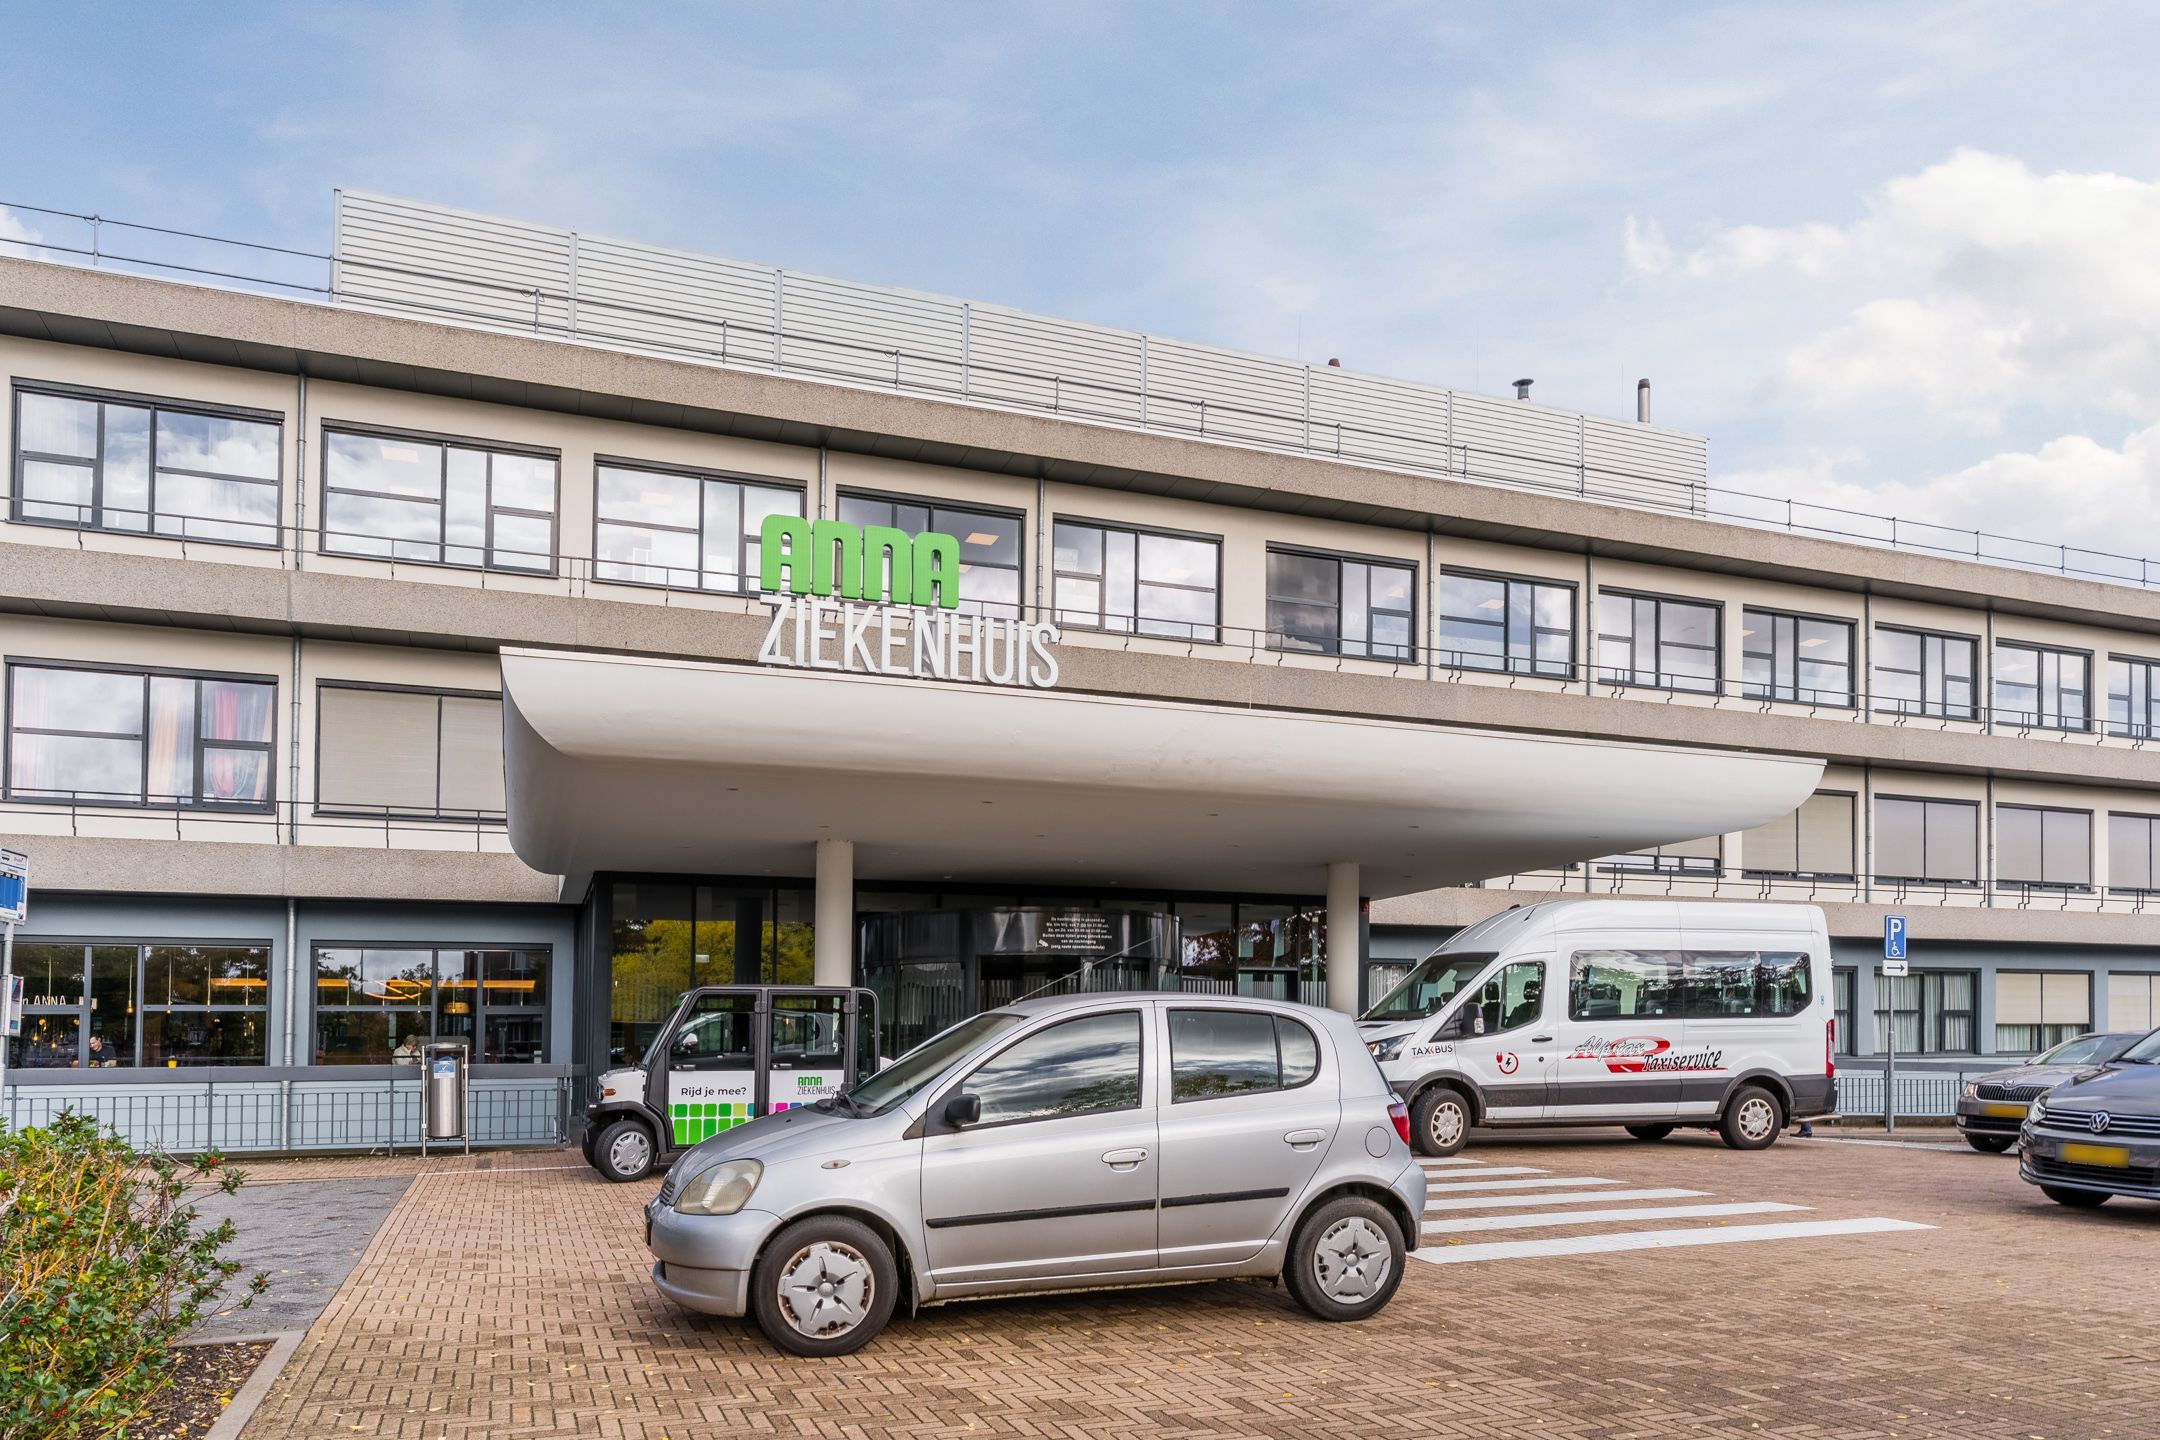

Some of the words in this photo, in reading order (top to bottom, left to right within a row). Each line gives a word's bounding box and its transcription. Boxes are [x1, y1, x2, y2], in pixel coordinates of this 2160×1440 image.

[760, 513, 960, 609] ANNA
[757, 594, 1060, 688] ZIEKENHUIS
[1890, 919, 1902, 940] P
[34, 995, 66, 1005] ANNA
[1642, 1045, 1722, 1071] Taxiservice
[797, 1076, 822, 1086] ANNA
[681, 1087, 702, 1098] Rijd
[704, 1087, 714, 1098] je
[717, 1087, 747, 1096] mee?
[797, 1086, 835, 1095] ZIEKENHUIS
